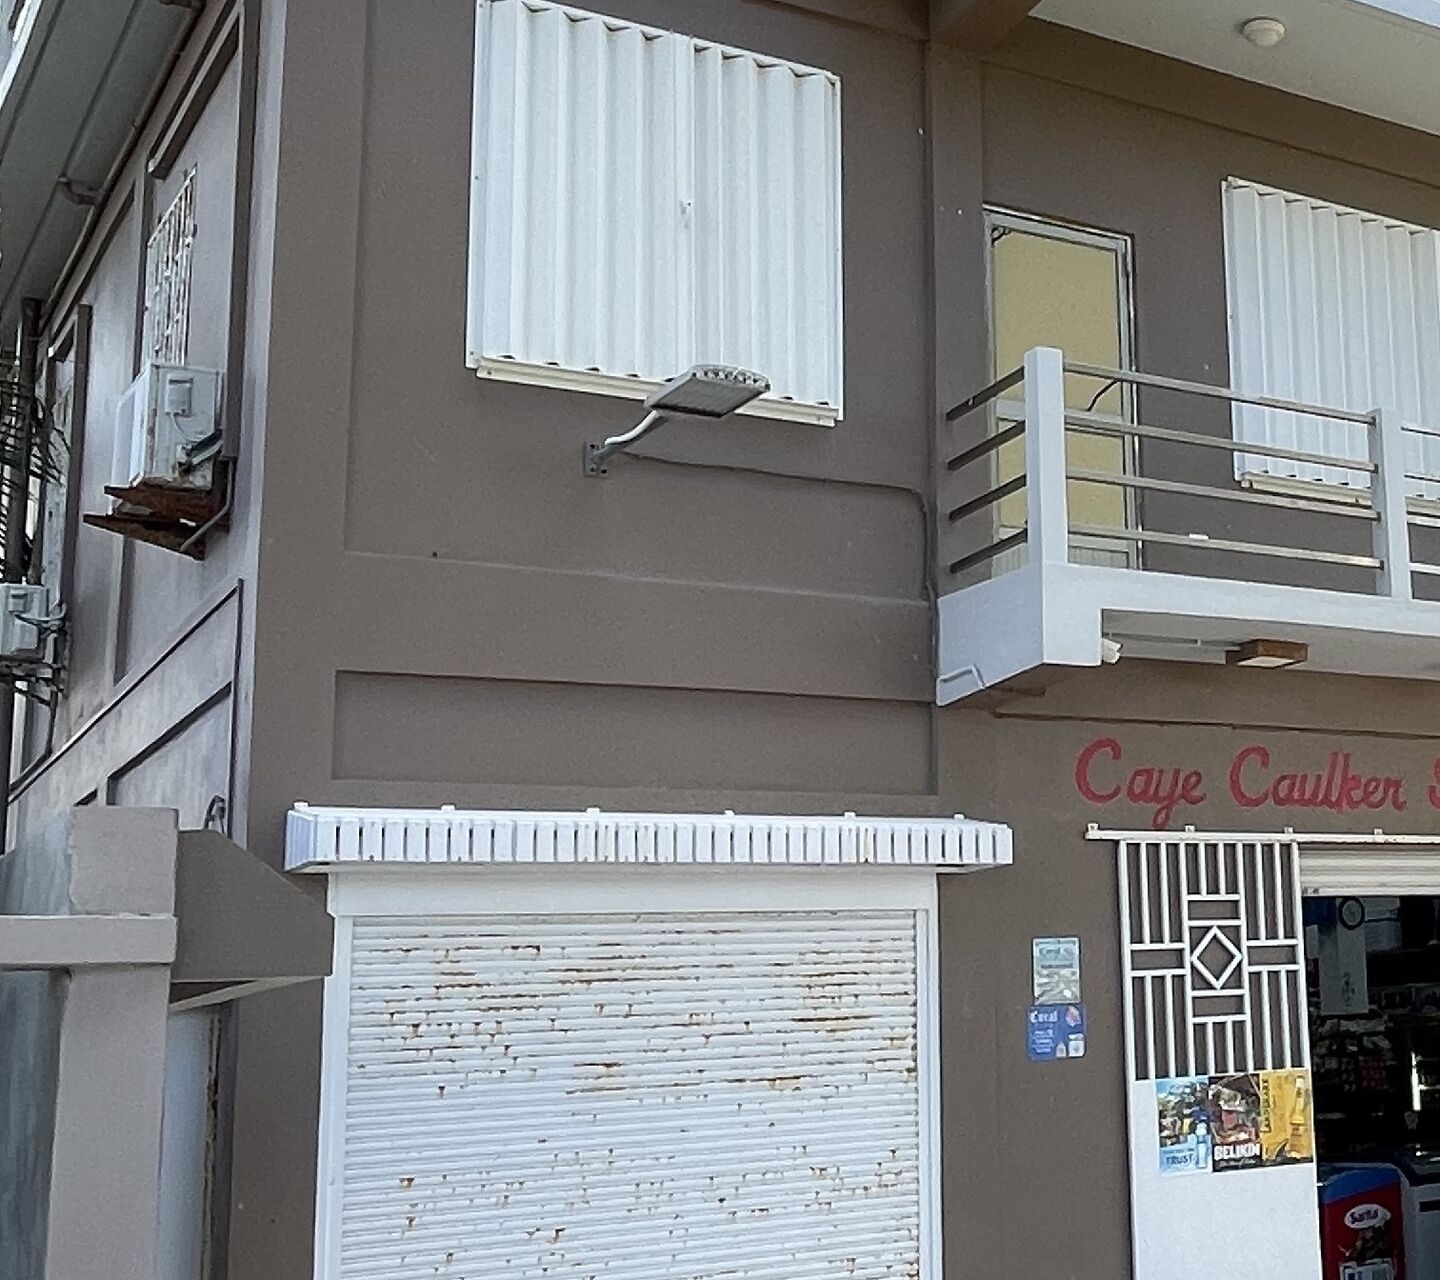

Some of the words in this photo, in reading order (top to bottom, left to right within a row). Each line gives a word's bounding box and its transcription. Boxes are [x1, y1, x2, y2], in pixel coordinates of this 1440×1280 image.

[1074, 738, 1207, 830] Caye
[1229, 745, 1409, 813] Caulker
[1166, 1152, 1194, 1166] TRUST
[1213, 1142, 1261, 1161] BELIKIN
